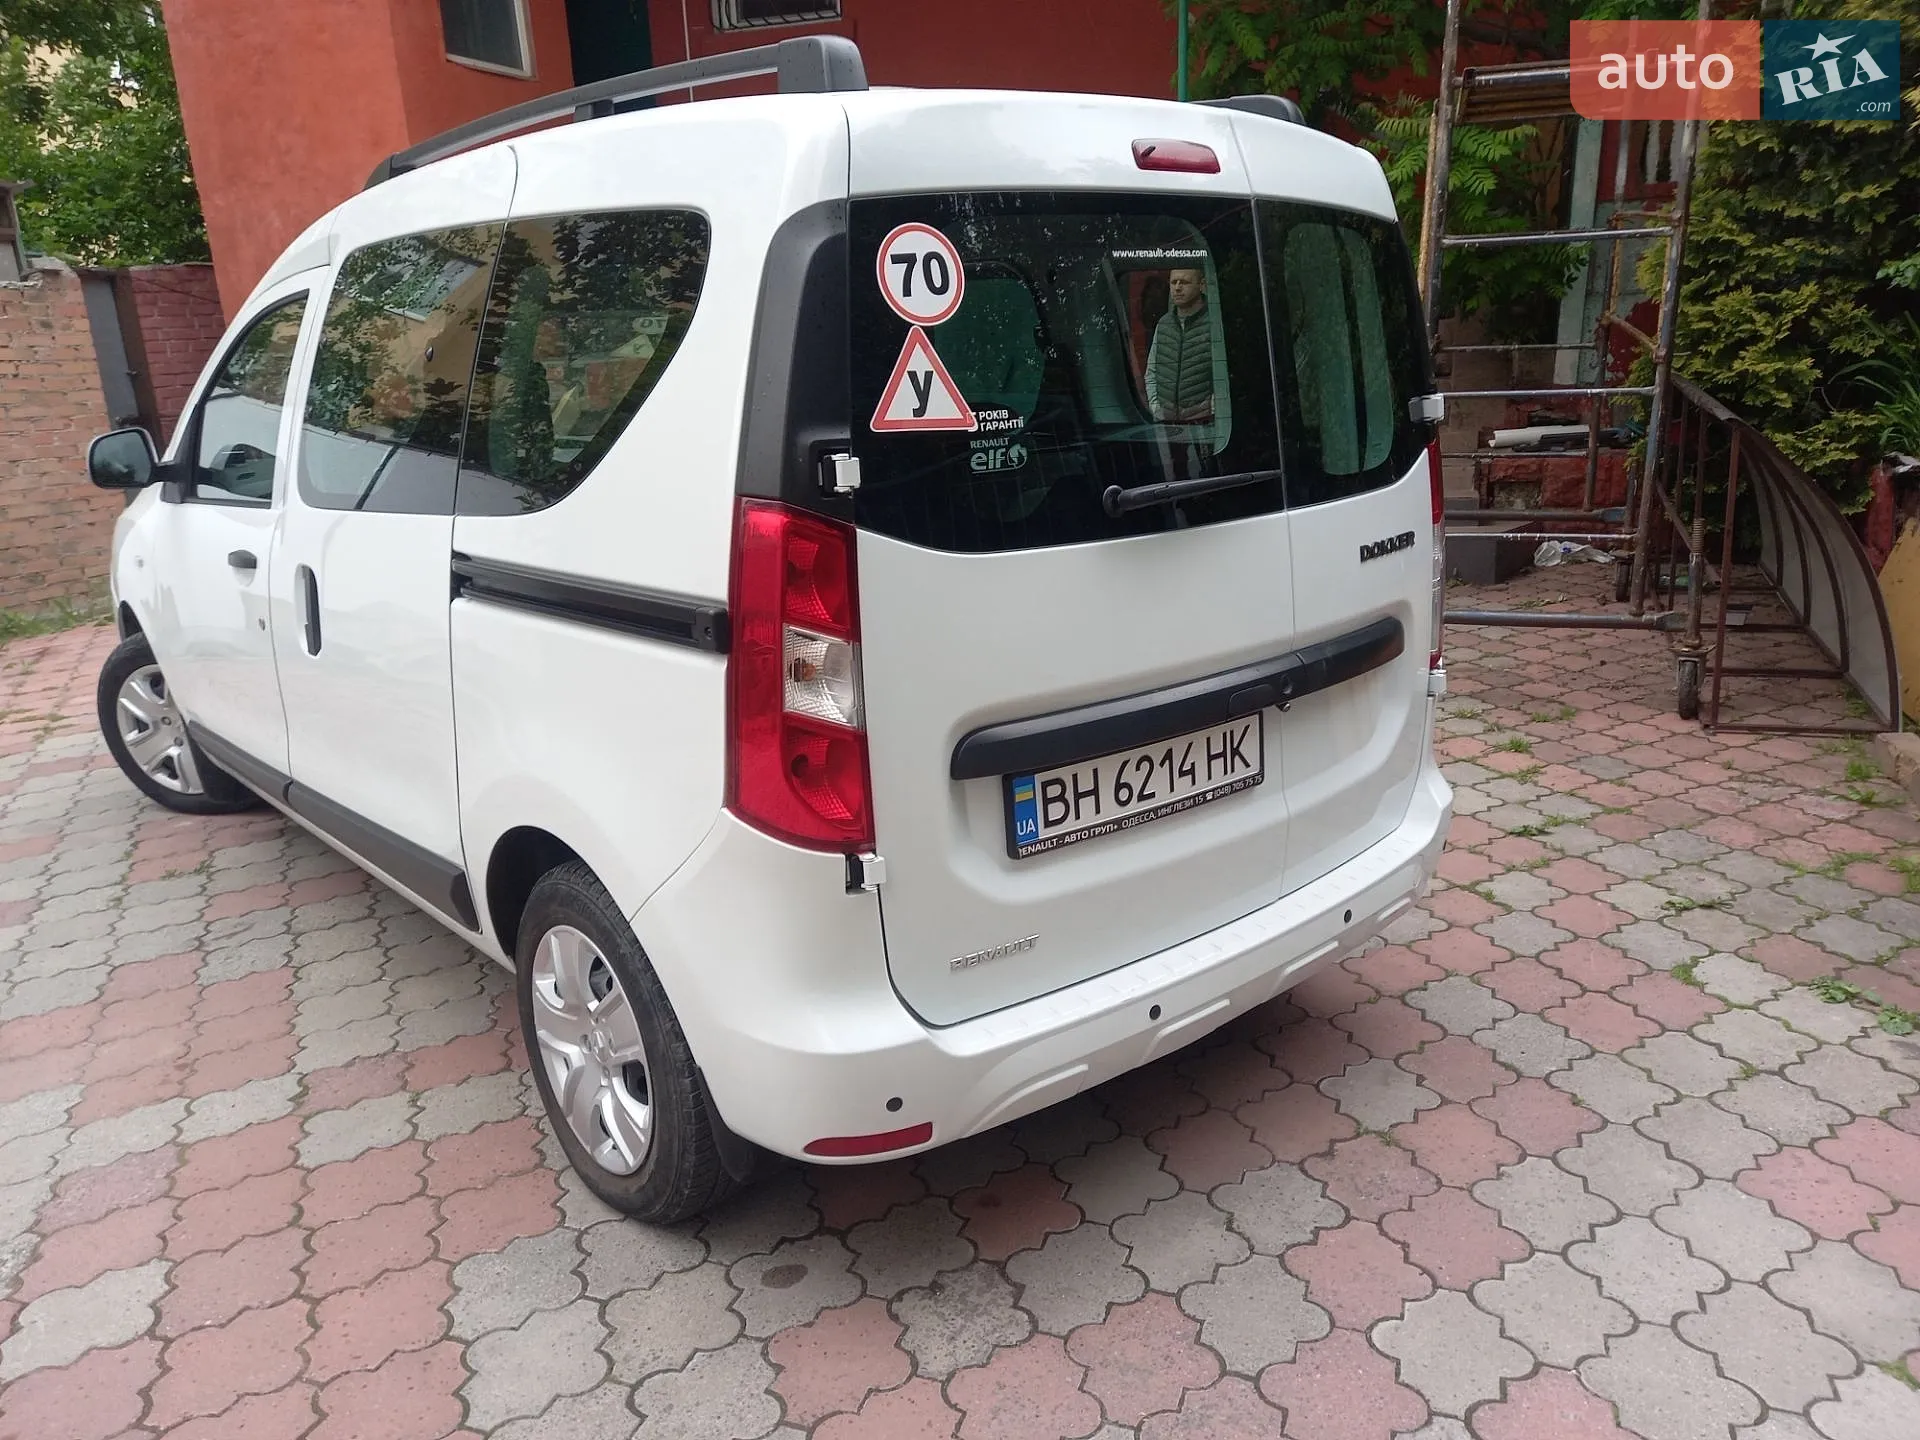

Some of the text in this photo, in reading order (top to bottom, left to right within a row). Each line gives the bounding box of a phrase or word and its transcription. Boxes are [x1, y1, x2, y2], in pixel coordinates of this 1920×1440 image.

[1111, 247, 1208, 258] www.renault-odessa.com
[889, 250, 950, 298] 70
[979, 409, 1009, 420] РОКІВ
[970, 437, 1010, 449] RENAULT
[970, 447, 1007, 471] elf
[1360, 530, 1416, 564] DOKKER
[1040, 724, 1252, 829] BH 6214 HK
[1016, 818, 1036, 836] UA
[1064, 830, 1089, 845] АВТО
[950, 934, 1040, 973] RENAULT
